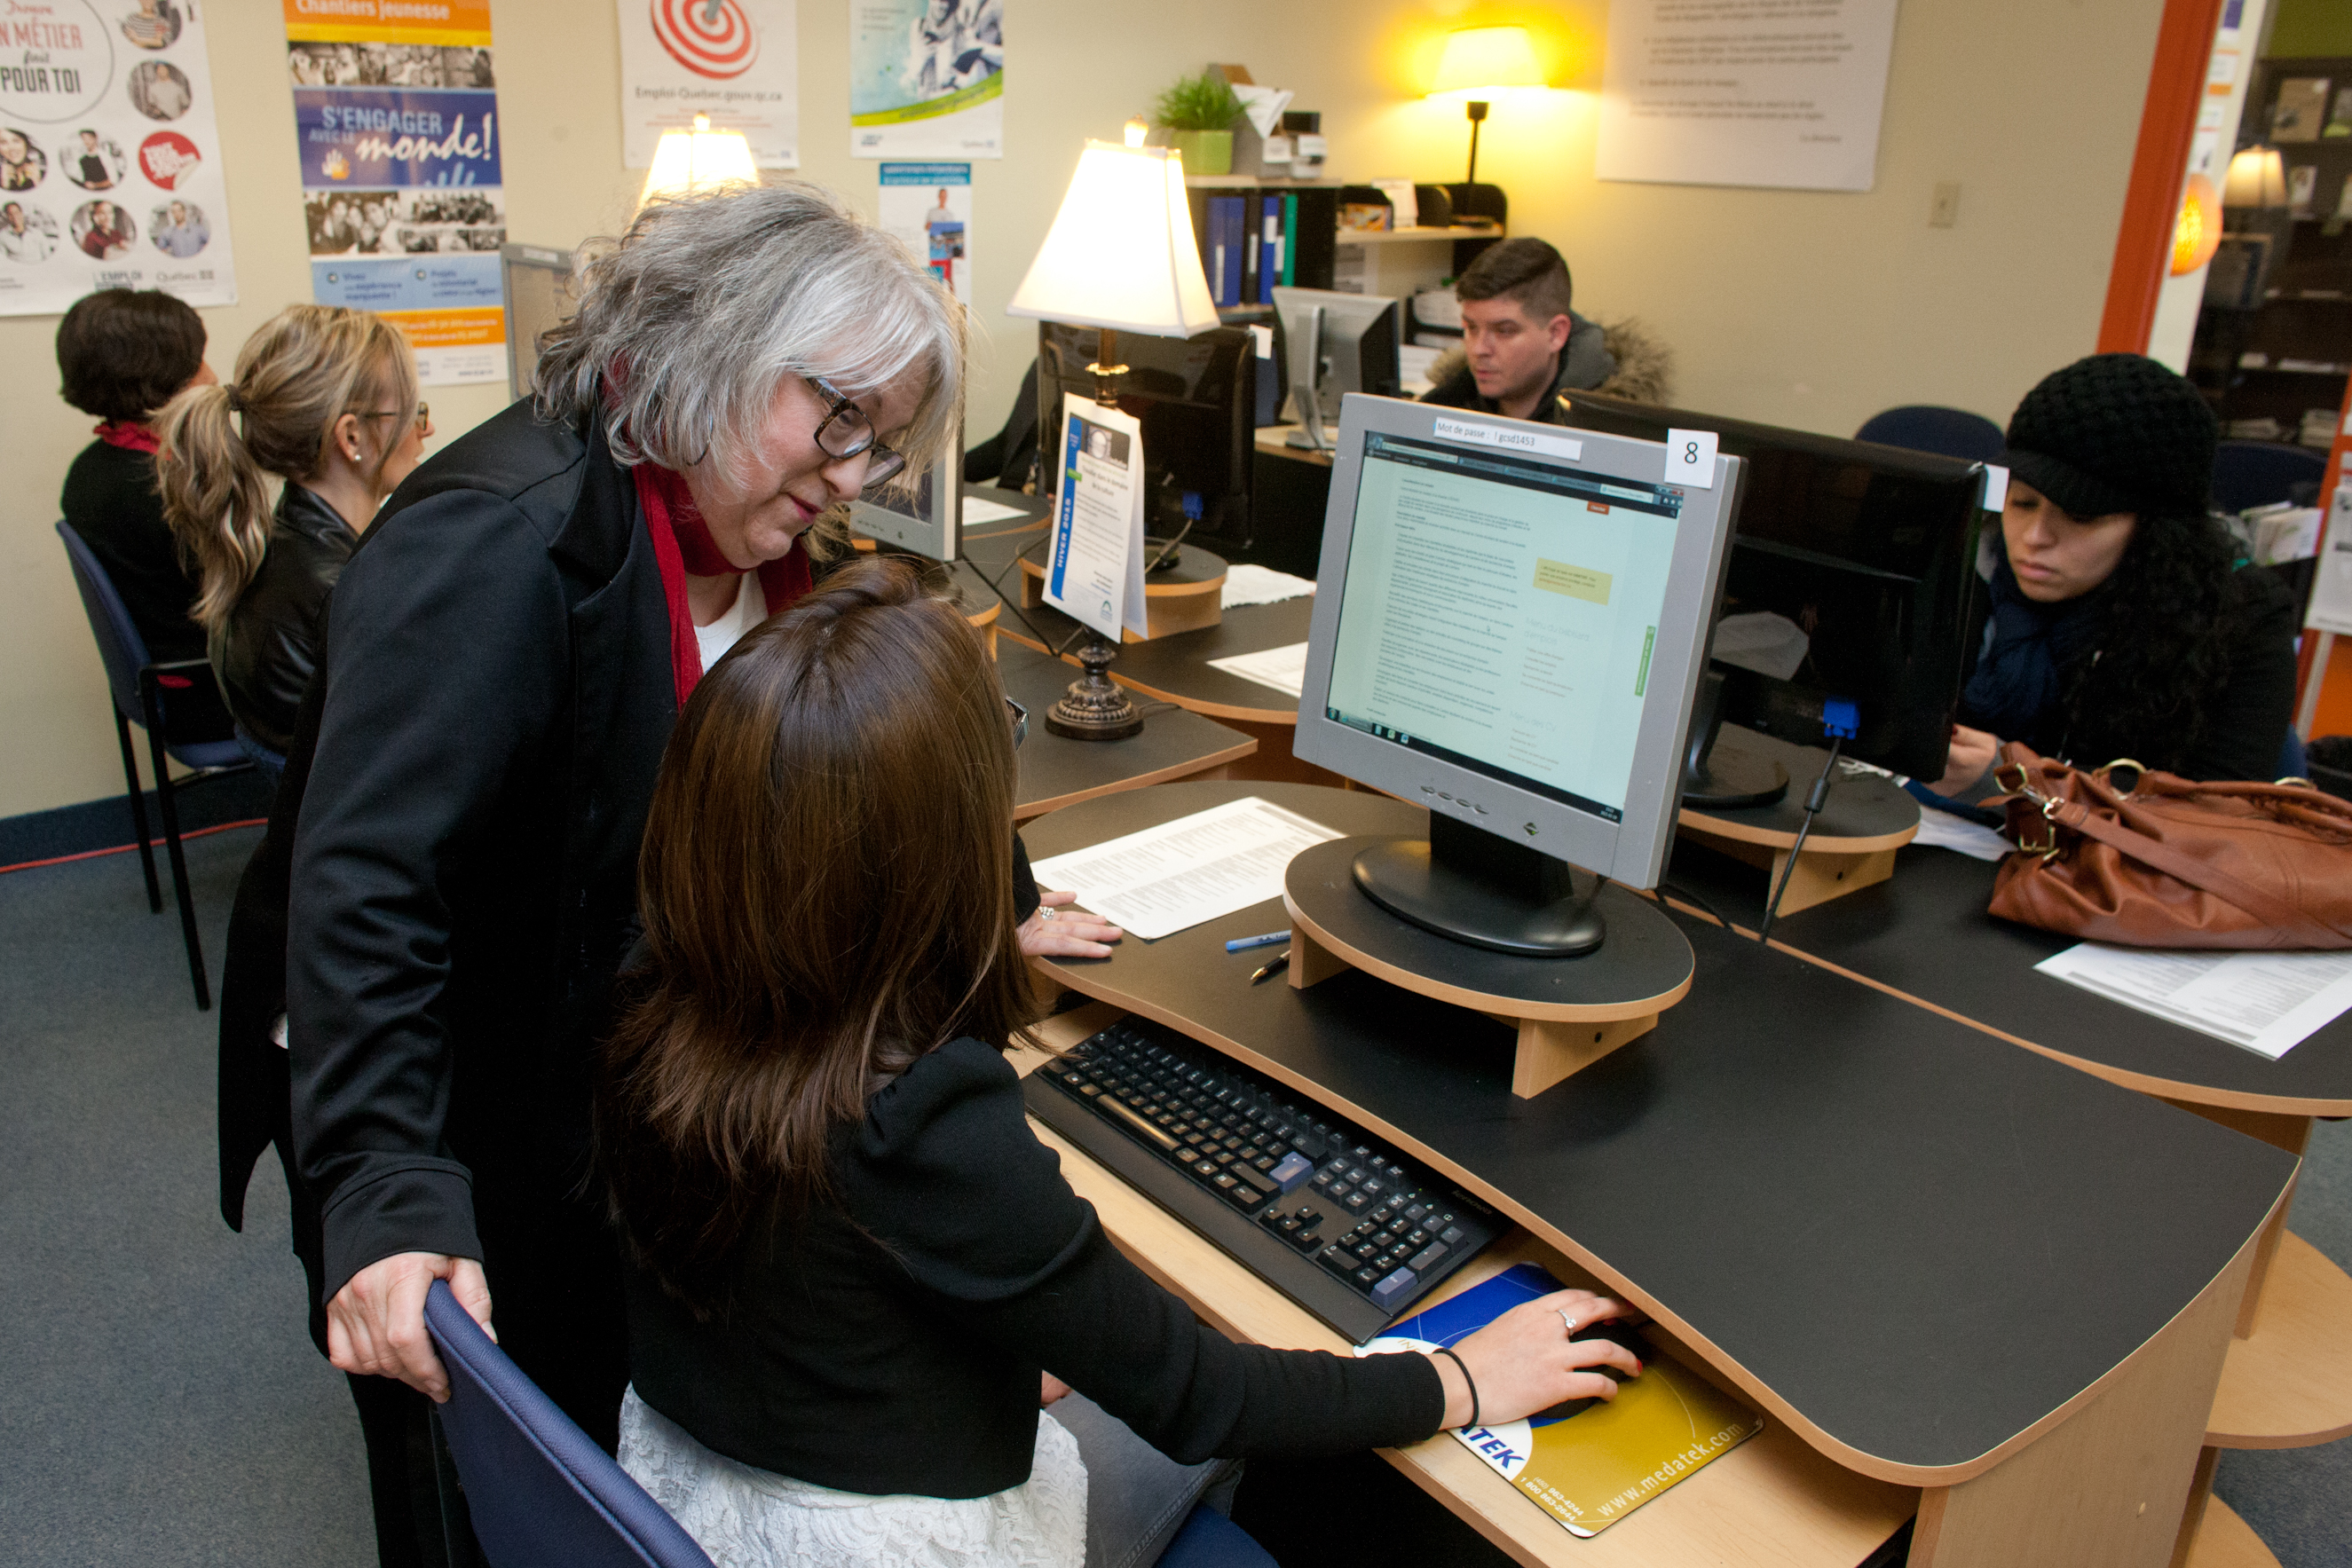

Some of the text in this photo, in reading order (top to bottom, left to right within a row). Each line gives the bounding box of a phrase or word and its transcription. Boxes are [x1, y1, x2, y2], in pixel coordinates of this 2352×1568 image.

[12, 16, 83, 50] MÉTIER
[0, 67, 82, 94] POUR TOI
[322, 105, 443, 136] S'ENGAGER
[1437, 422, 1453, 433] Mot
[1454, 424, 1464, 434] de
[1464, 427, 1486, 438] passe
[1498, 434, 1535, 446] gcsd1453
[1685, 442, 1698, 463] 8
[1057, 532, 1068, 568] HIVER
[1597, 1422, 1744, 1517] www.medatek.com
[1526, 1481, 1540, 1495] 800
[1540, 1493, 1576, 1522] 863-2644
[1534, 1476, 1584, 1517] (450) 963-4244
